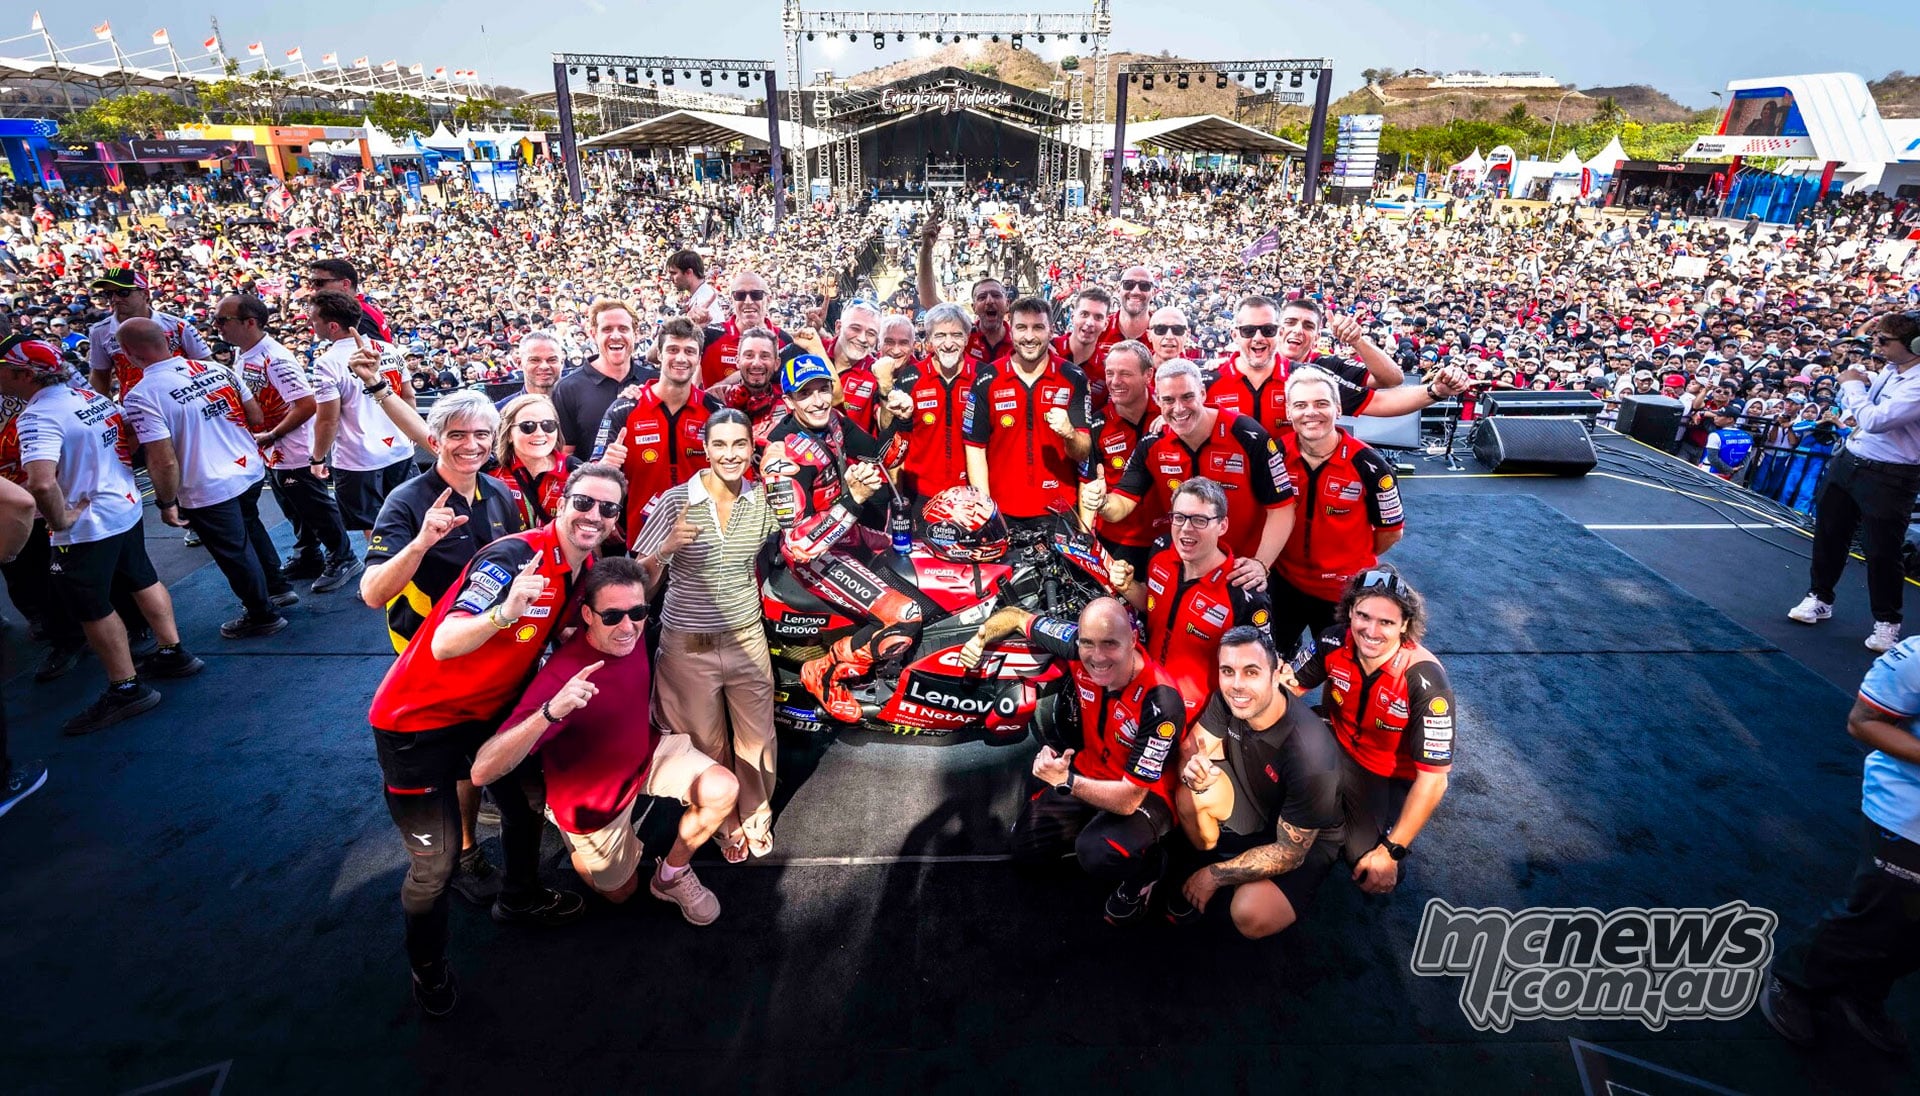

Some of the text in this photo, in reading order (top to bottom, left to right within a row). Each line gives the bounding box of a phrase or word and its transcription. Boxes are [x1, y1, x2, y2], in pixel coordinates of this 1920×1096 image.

[881, 87, 1012, 116] Energizing Indonesia
[168, 373, 225, 401] Enduro
[177, 388, 207, 405] VR46
[809, 518, 834, 540] Lenovo
[823, 523, 847, 545] Unipol
[932, 525, 956, 535] Estrella
[932, 531, 955, 540] Galicia
[491, 566, 508, 582] TIM
[840, 555, 889, 588] DUCATI
[924, 568, 955, 576] DUCATI
[479, 574, 500, 592] riello
[827, 563, 872, 600] Lenovo
[529, 606, 549, 615] riello
[784, 614, 827, 625] Lenovo
[775, 624, 819, 635] Lenovo
[893, 718, 926, 727] SIEMENS
